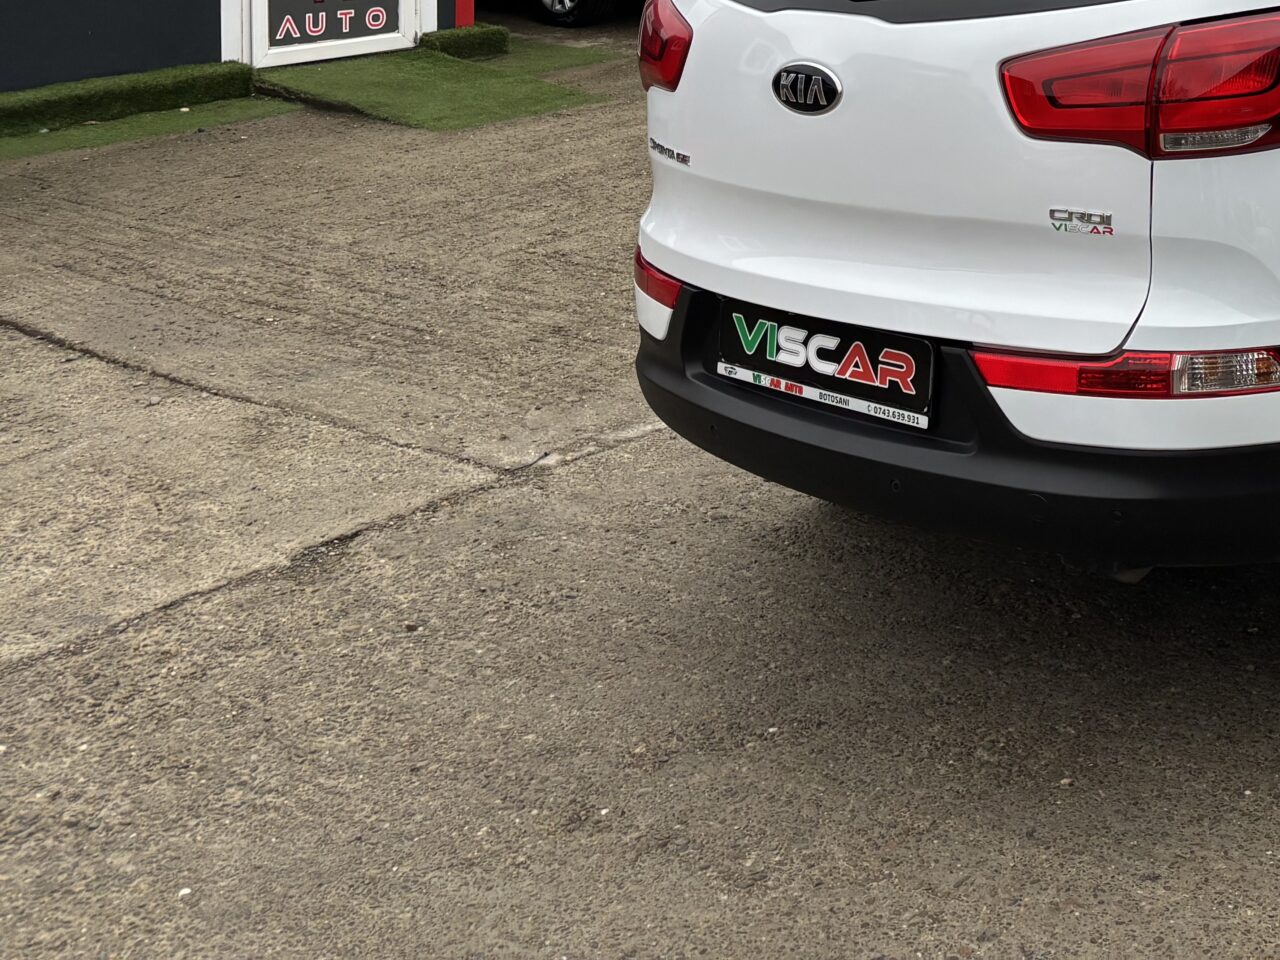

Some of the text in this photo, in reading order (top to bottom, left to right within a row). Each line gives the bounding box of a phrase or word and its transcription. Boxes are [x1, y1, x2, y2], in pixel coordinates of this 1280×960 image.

[276, 7, 387, 40] AUTO
[780, 72, 828, 106] KIA
[1051, 222, 1114, 236] VISCAR
[732, 313, 916, 395] VISCAR
[818, 391, 850, 407] BOTOSANI
[873, 405, 920, 425] 0743.639.931
